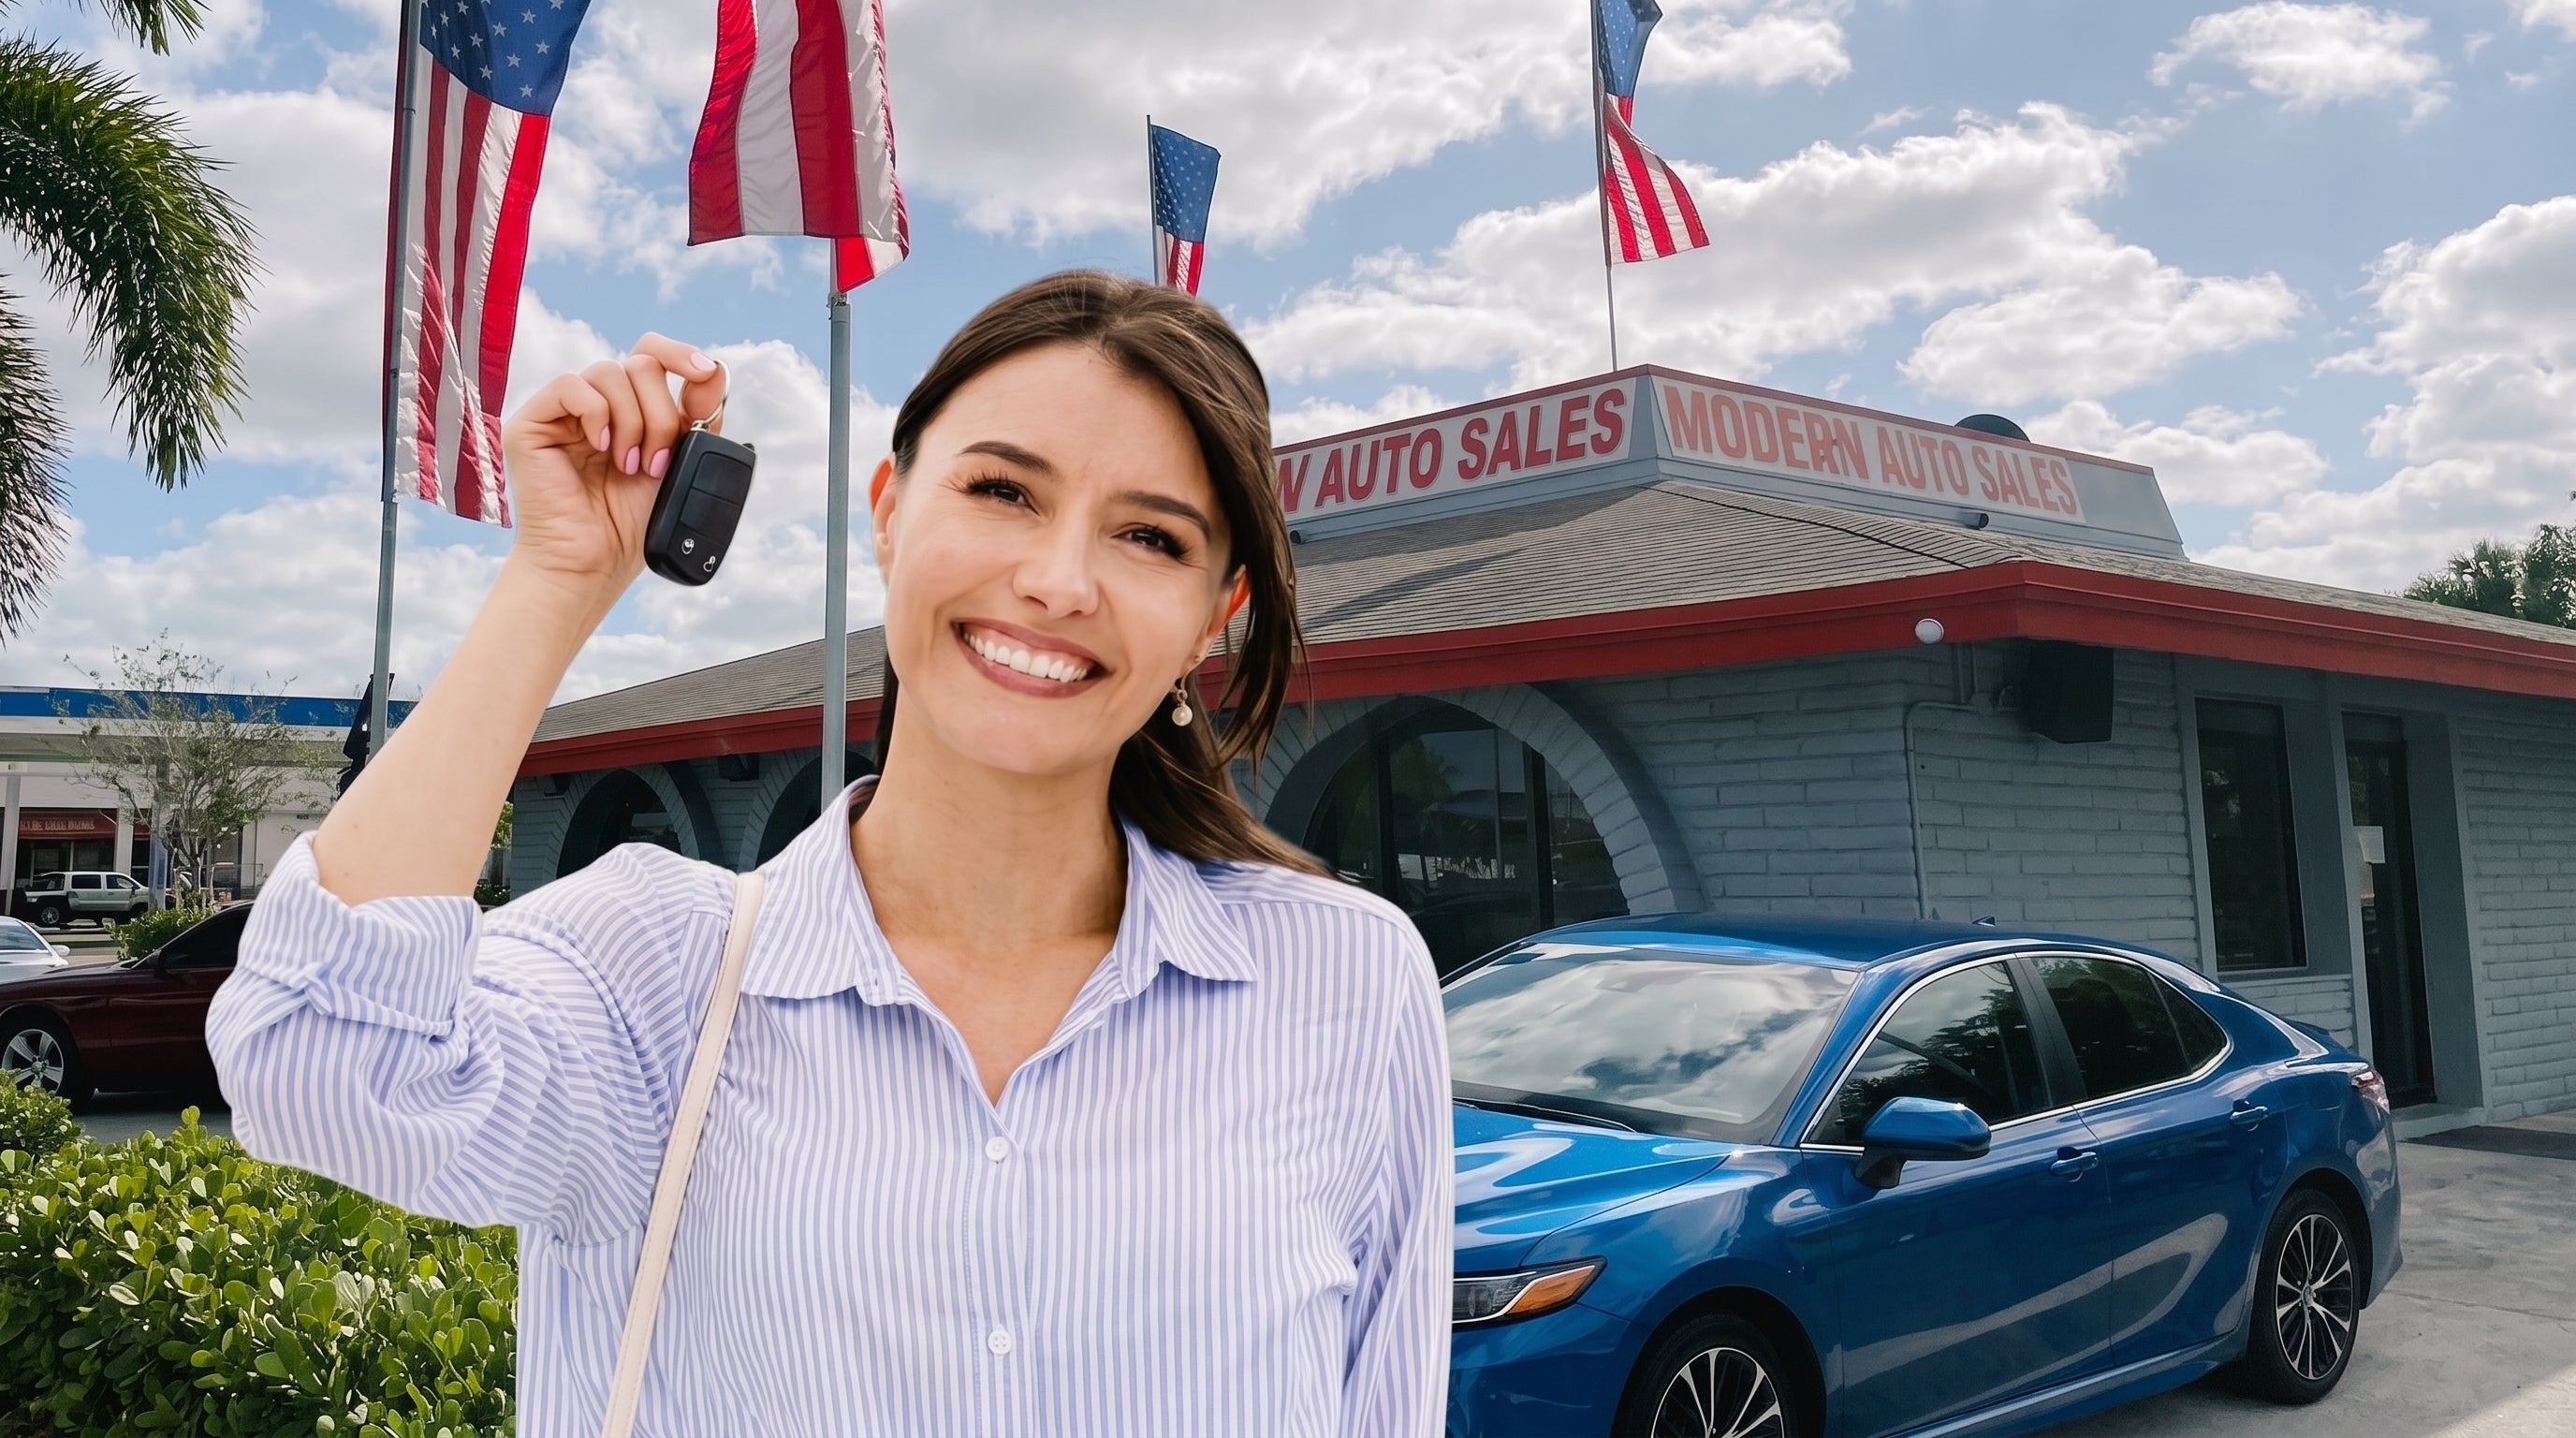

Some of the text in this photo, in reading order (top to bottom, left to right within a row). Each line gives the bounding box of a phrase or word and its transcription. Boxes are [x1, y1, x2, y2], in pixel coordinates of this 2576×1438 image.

[1314, 427, 1443, 509] AUTO
[1456, 388, 1626, 482] SALES
[1662, 384, 2078, 516] MODERN AUTO SALES
